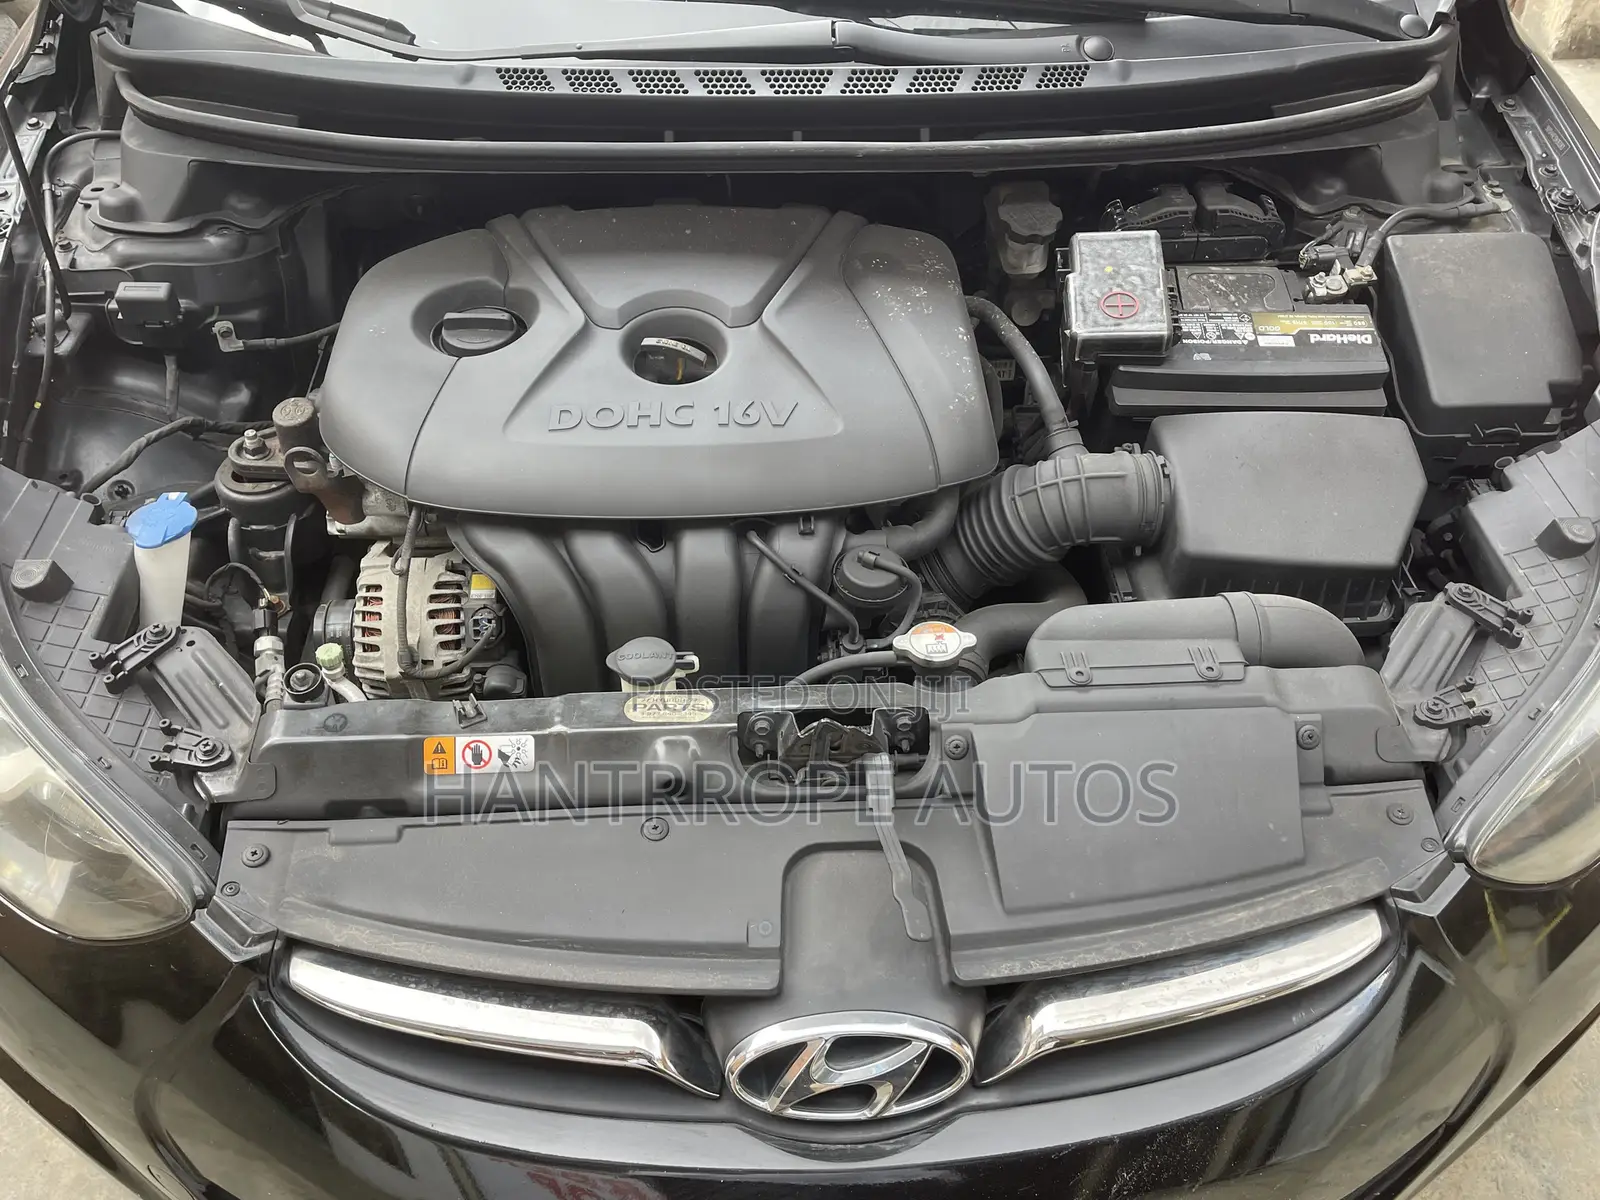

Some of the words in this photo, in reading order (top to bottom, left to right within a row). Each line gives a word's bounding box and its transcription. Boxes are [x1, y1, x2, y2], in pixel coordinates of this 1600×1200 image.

[1308, 333, 1373, 345] DieHard
[548, 401, 694, 431] DOHC
[713, 401, 798, 427] 16V
[617, 651, 675, 661] COOLANT
[632, 703, 706, 713] PARTS
